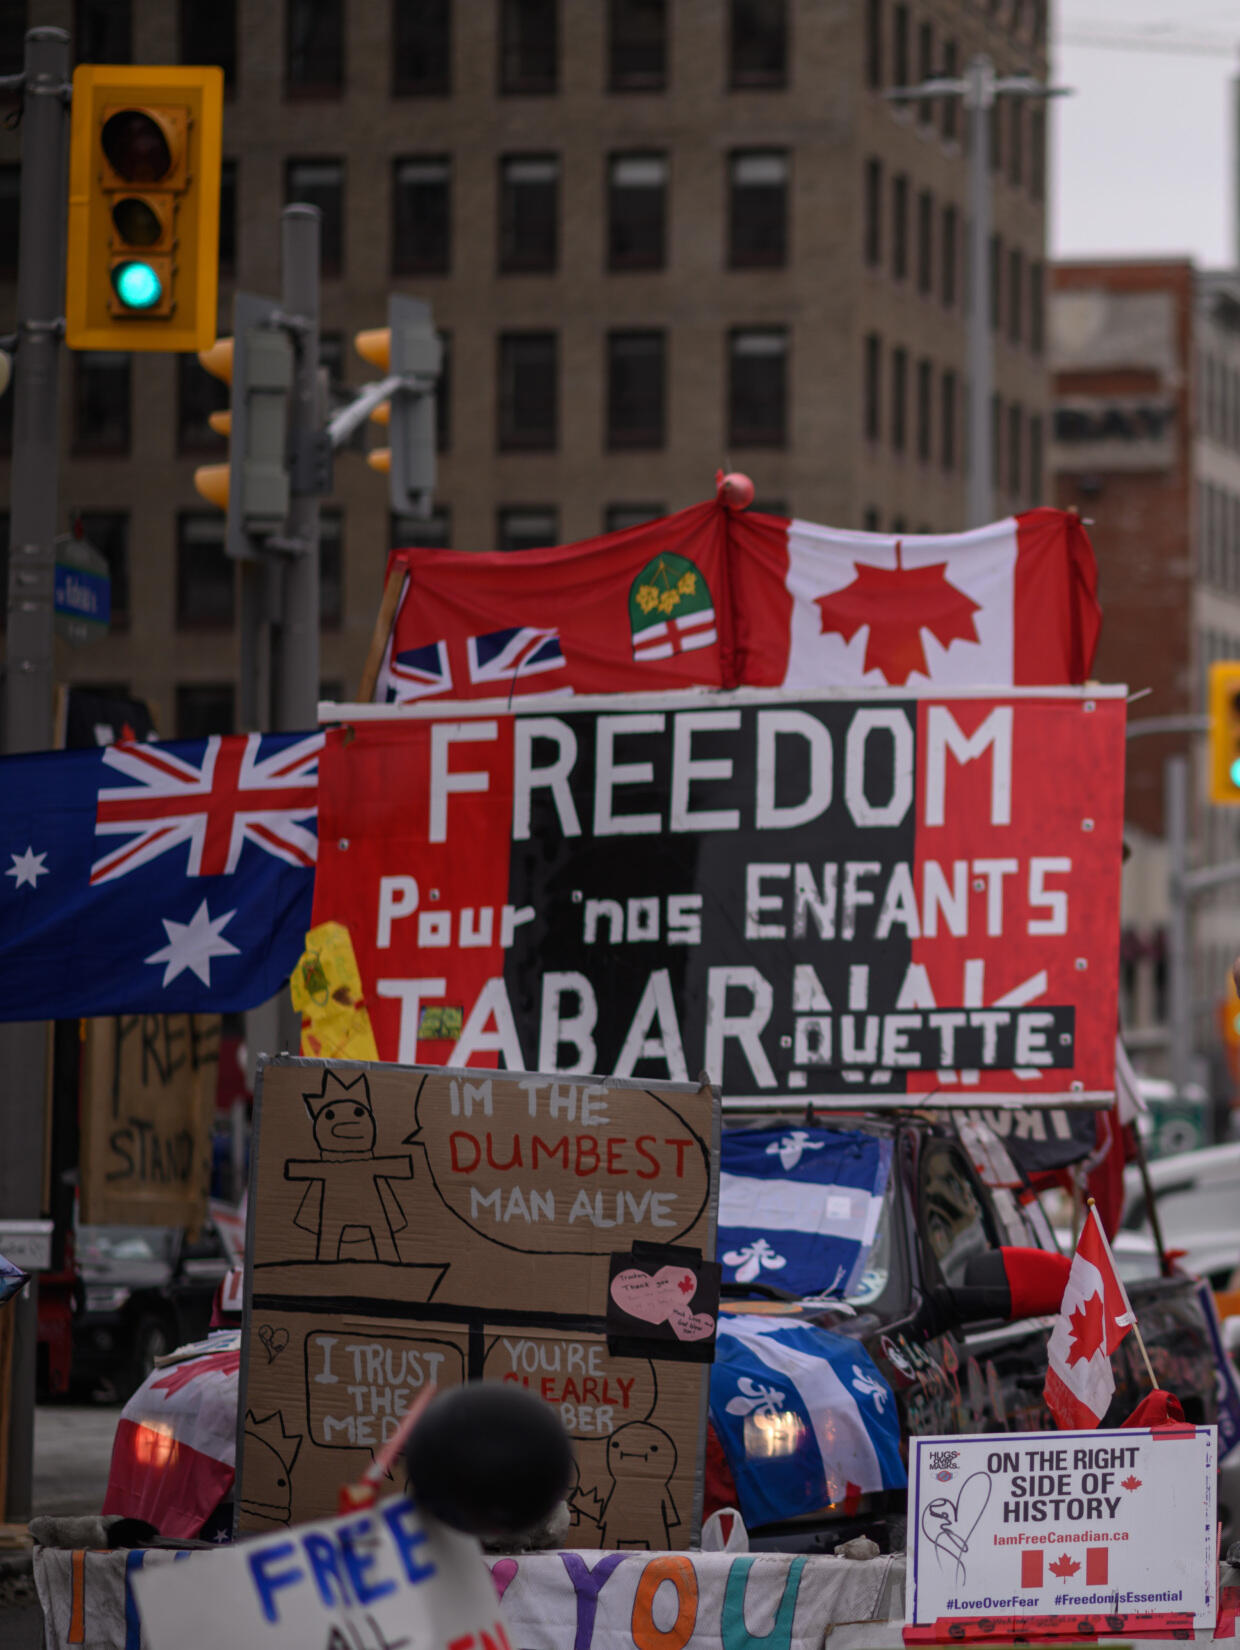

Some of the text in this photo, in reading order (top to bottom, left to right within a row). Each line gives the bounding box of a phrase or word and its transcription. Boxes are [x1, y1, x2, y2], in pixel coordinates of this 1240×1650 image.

[429, 705, 1014, 843] FREEDOM
[376, 856, 1071, 949] Pour nos ENFANTS
[518, 1081, 610, 1126] THE
[449, 1131, 695, 1180] DUMBEST
[469, 1185, 679, 1227] MAN ALIVE
[314, 1337, 446, 1388] I TRUST
[503, 1338, 607, 1376] YOU'RE
[346, 1385, 413, 1417] THE
[503, 1372, 636, 1409] EARLY
[322, 1415, 402, 1445] MED
[987, 1447, 1140, 1474] ON THE RIGHT
[1011, 1472, 1115, 1498] SIDE OF
[1003, 1496, 1122, 1523] HISTORY
[993, 1530, 1129, 1546] IamFreeCanadian.ca
[245, 1497, 437, 1625] FREE
[557, 1553, 806, 1650] YOU
[946, 1590, 1183, 1610] #LoveOverFear #FreedomIsEssential
